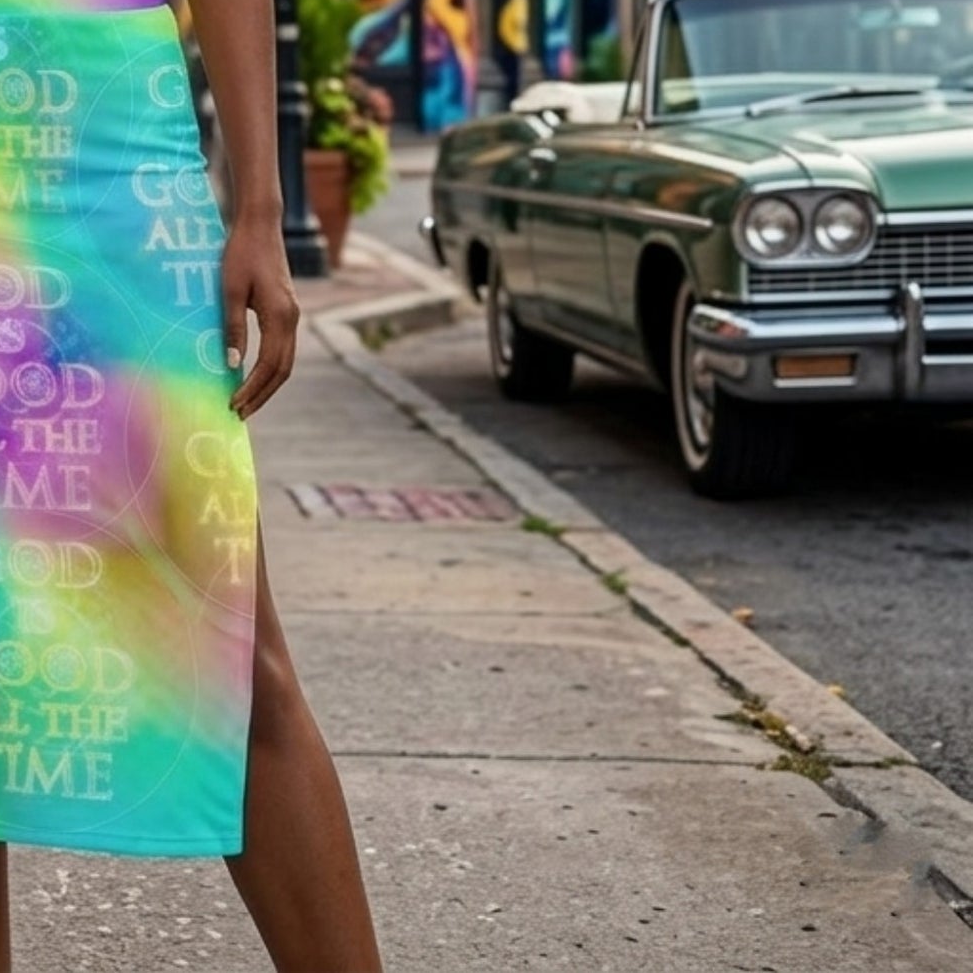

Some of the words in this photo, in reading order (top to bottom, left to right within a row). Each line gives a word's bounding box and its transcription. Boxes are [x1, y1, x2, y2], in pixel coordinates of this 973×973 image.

[12, 418, 103, 454] THE
[15, 597, 56, 635] IS
[39, 702, 128, 743] THE
